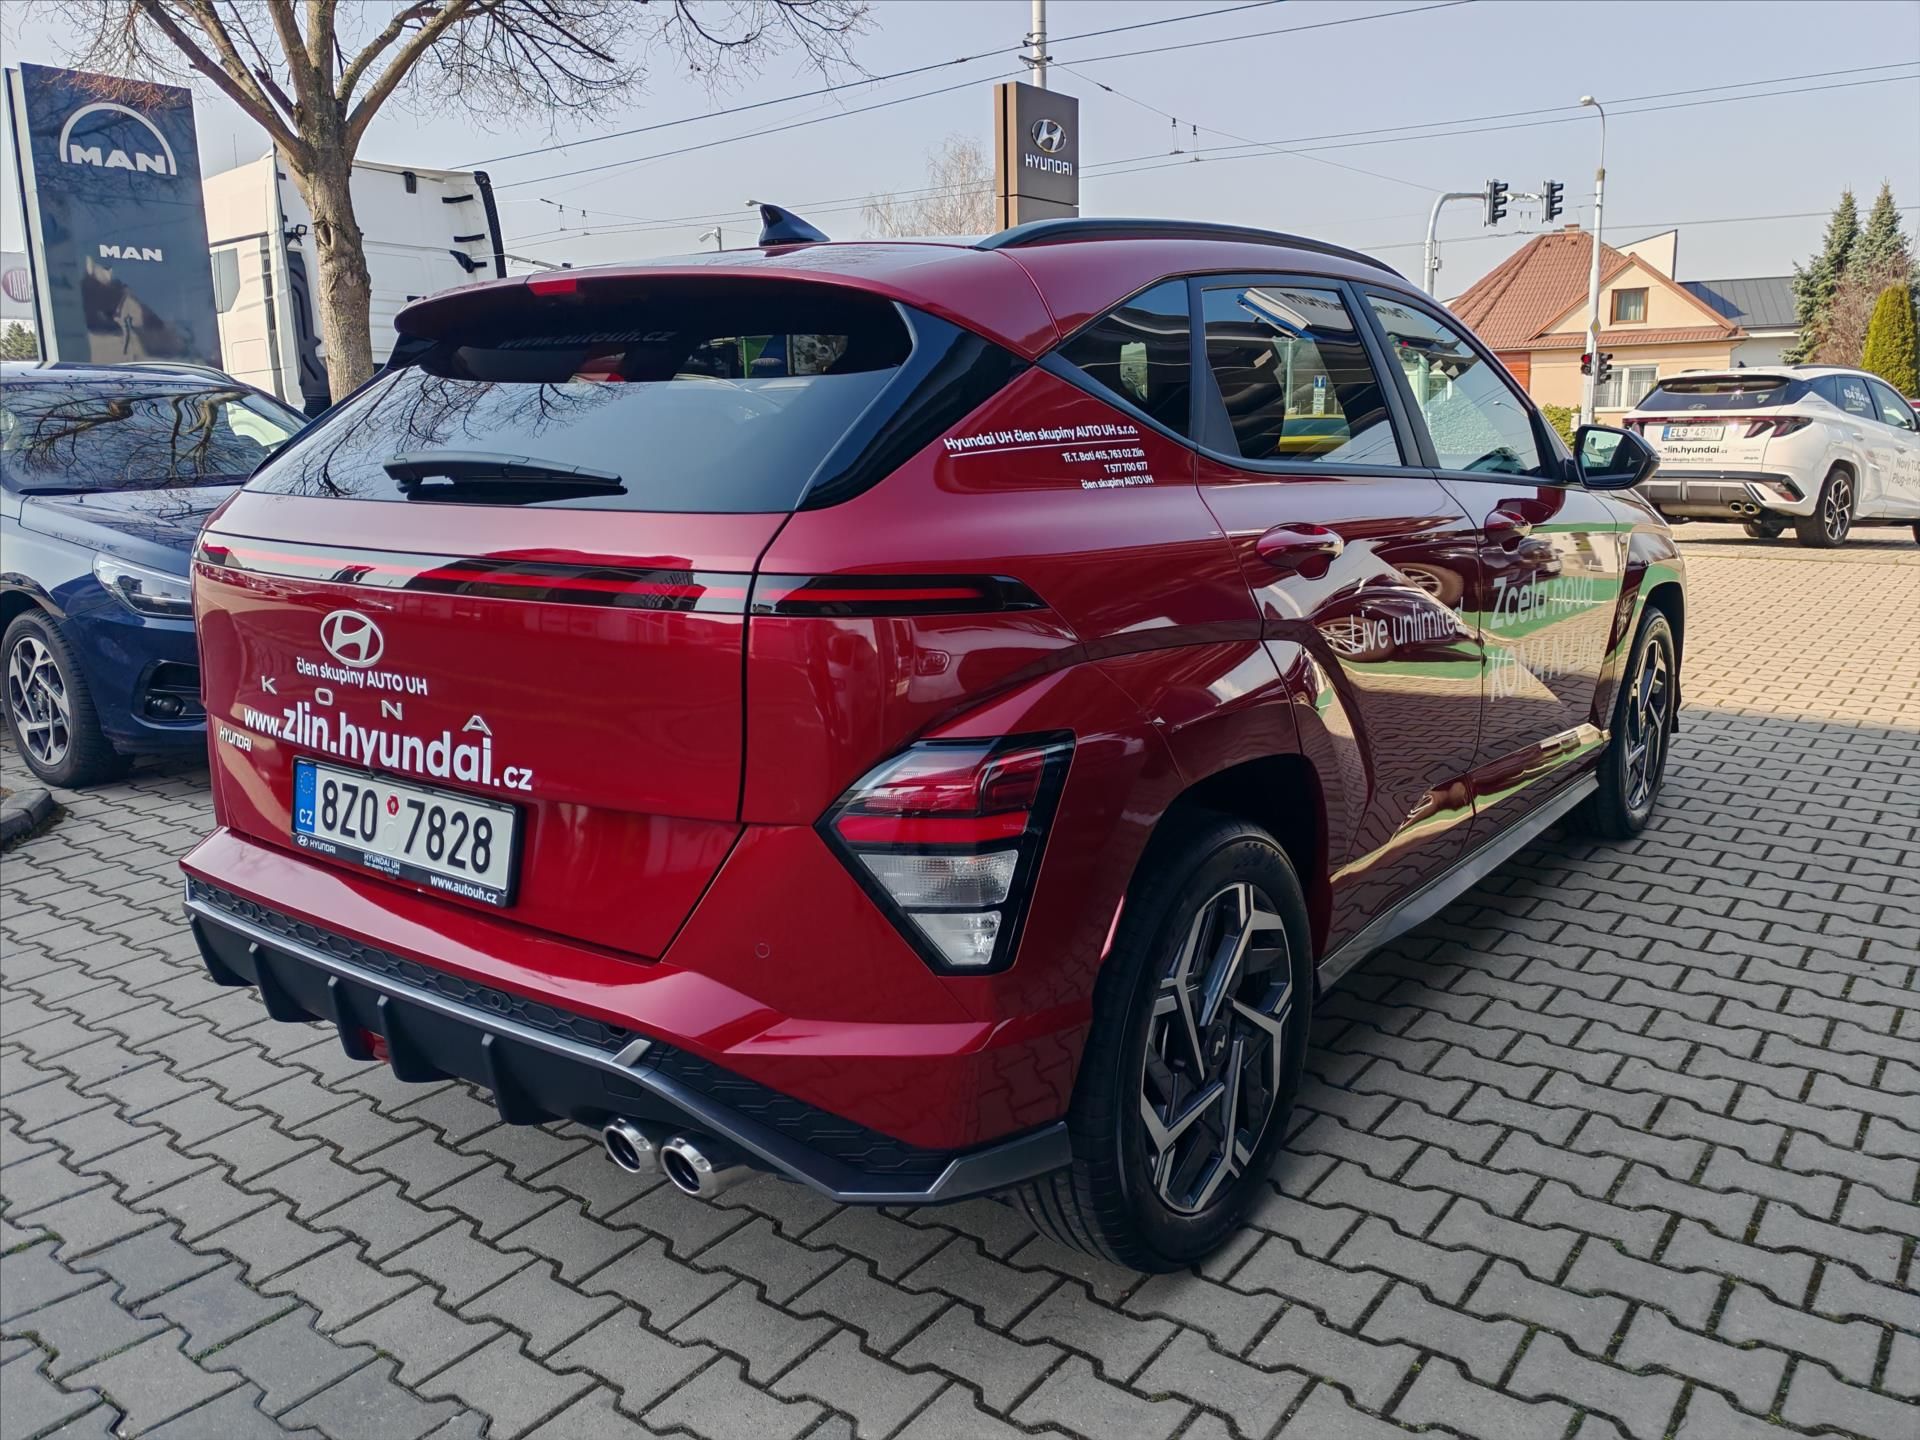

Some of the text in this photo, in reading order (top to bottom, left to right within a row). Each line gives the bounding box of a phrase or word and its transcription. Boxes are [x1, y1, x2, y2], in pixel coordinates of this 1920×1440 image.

[69, 143, 167, 175] MAN
[1025, 152, 1073, 176] HYUNDAI
[98, 244, 163, 262] MAN
[943, 423, 1139, 451] Hyundai UH člen skupiny AUTO UH s.r.o.
[1670, 427, 1688, 438] EL9
[1104, 461, 1148, 473] T 577 700 677
[1110, 449, 1122, 459] 763
[1123, 448, 1131, 457] 02
[1081, 474, 1154, 489] člen skupiny AUTO UH
[1490, 569, 1547, 630] Zcela
[1350, 596, 1464, 655] Live unlimited
[296, 656, 428, 696] člen skupiny AUTO UH
[1489, 639, 1546, 703] KONA
[219, 725, 253, 753] HYUNDAI
[243, 701, 534, 792] www.zlin.hyundai.cz
[299, 807, 314, 827] CZ
[321, 779, 494, 875] 8Z0 7828
[309, 838, 337, 855] HYUNDAI
[363, 853, 400, 870] HYUNDAI UH
[429, 875, 497, 905] www.autouh.cz
